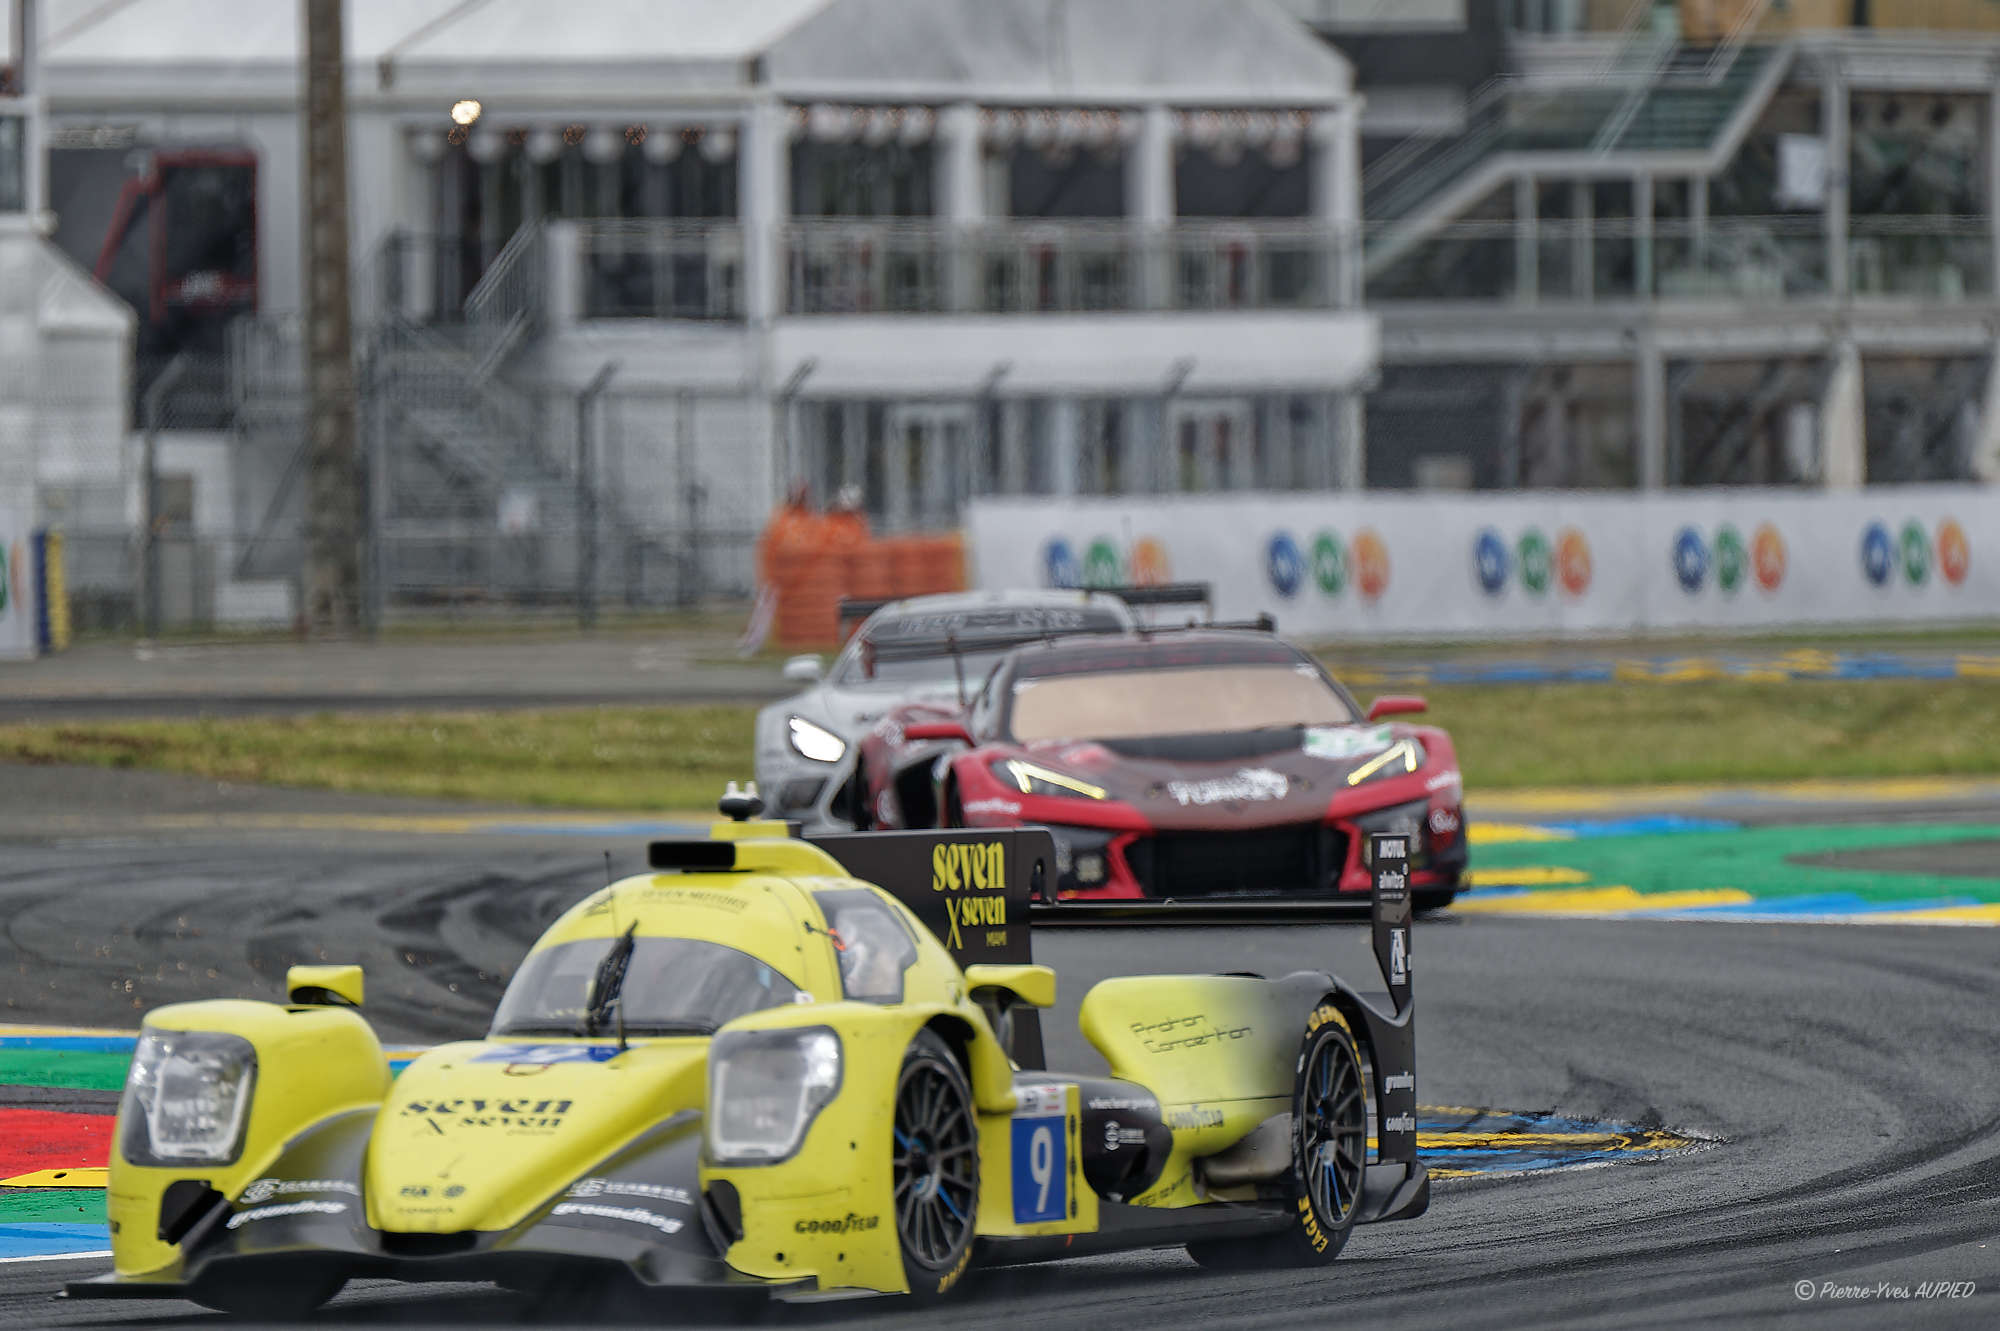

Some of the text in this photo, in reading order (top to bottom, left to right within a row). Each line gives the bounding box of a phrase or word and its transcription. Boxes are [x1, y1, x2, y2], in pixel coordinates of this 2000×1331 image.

[1379, 839, 1406, 858] MOTUL
[932, 841, 1005, 891] seven
[962, 896, 1006, 926] seven
[401, 1099, 572, 1115] seven
[458, 1116, 562, 1128] seven
[1030, 1126, 1054, 1214] 9
[795, 1212, 880, 1235] GOODYEAR
